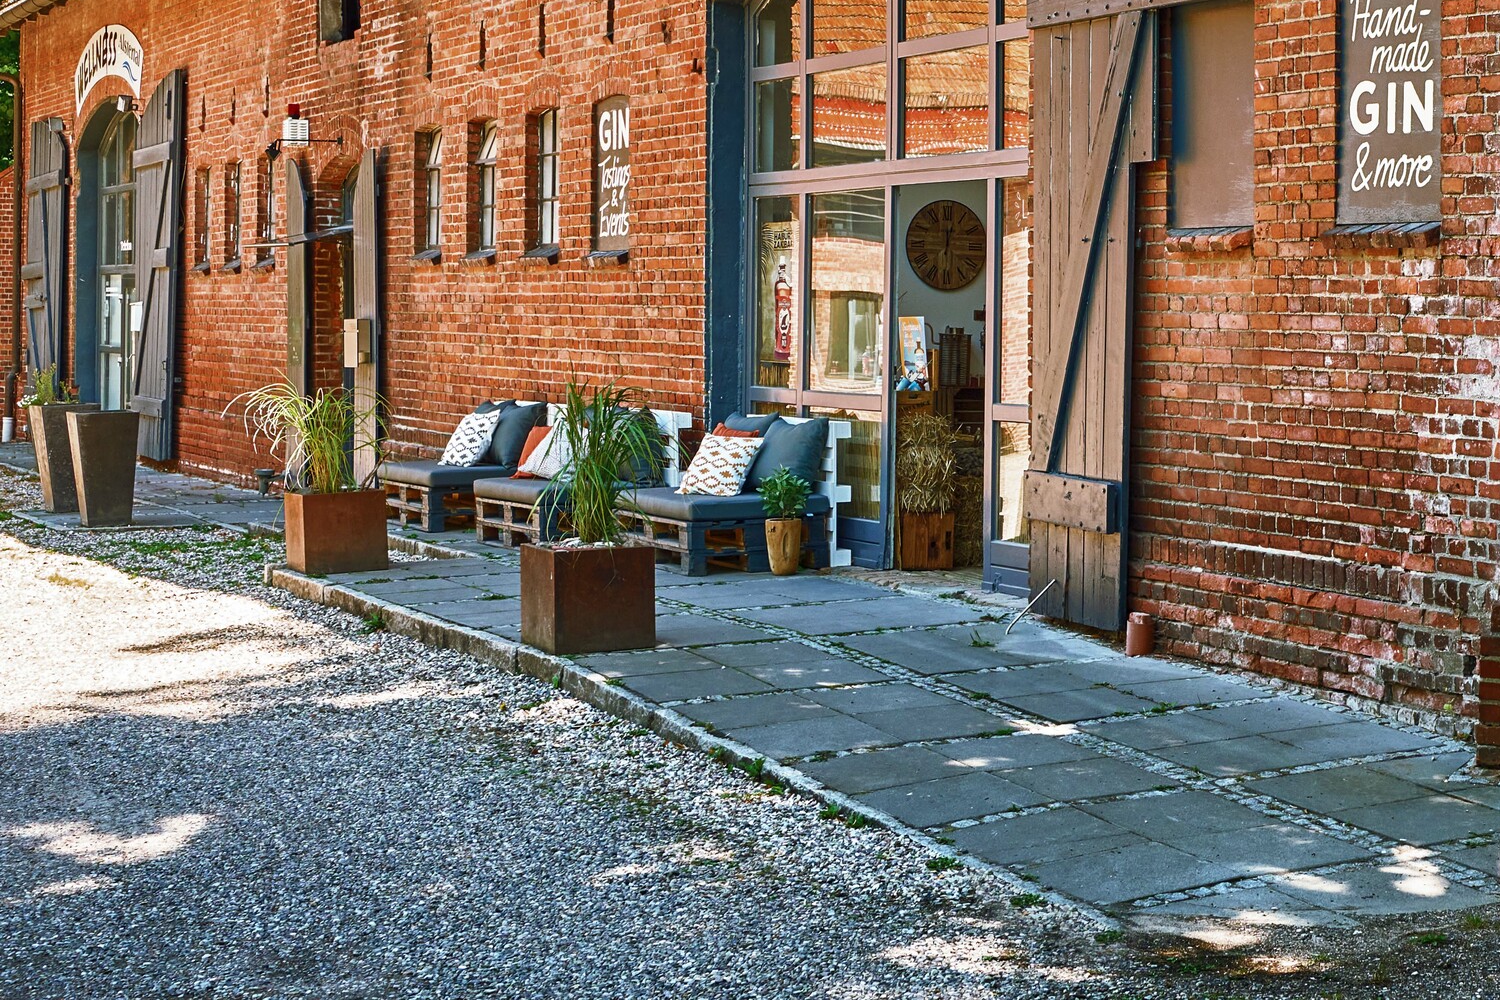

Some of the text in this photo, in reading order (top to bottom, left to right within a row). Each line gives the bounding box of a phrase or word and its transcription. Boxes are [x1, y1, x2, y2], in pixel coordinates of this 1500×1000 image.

[77, 32, 117, 104] WELLNESS
[119, 33, 140, 67] Alstertal
[1369, 23, 1434, 74] made
[599, 107, 630, 152] GIN
[1350, 79, 1434, 135] GIN
[598, 155, 631, 200] Tastings
[611, 189, 618, 207] &
[599, 200, 630, 237] Events
